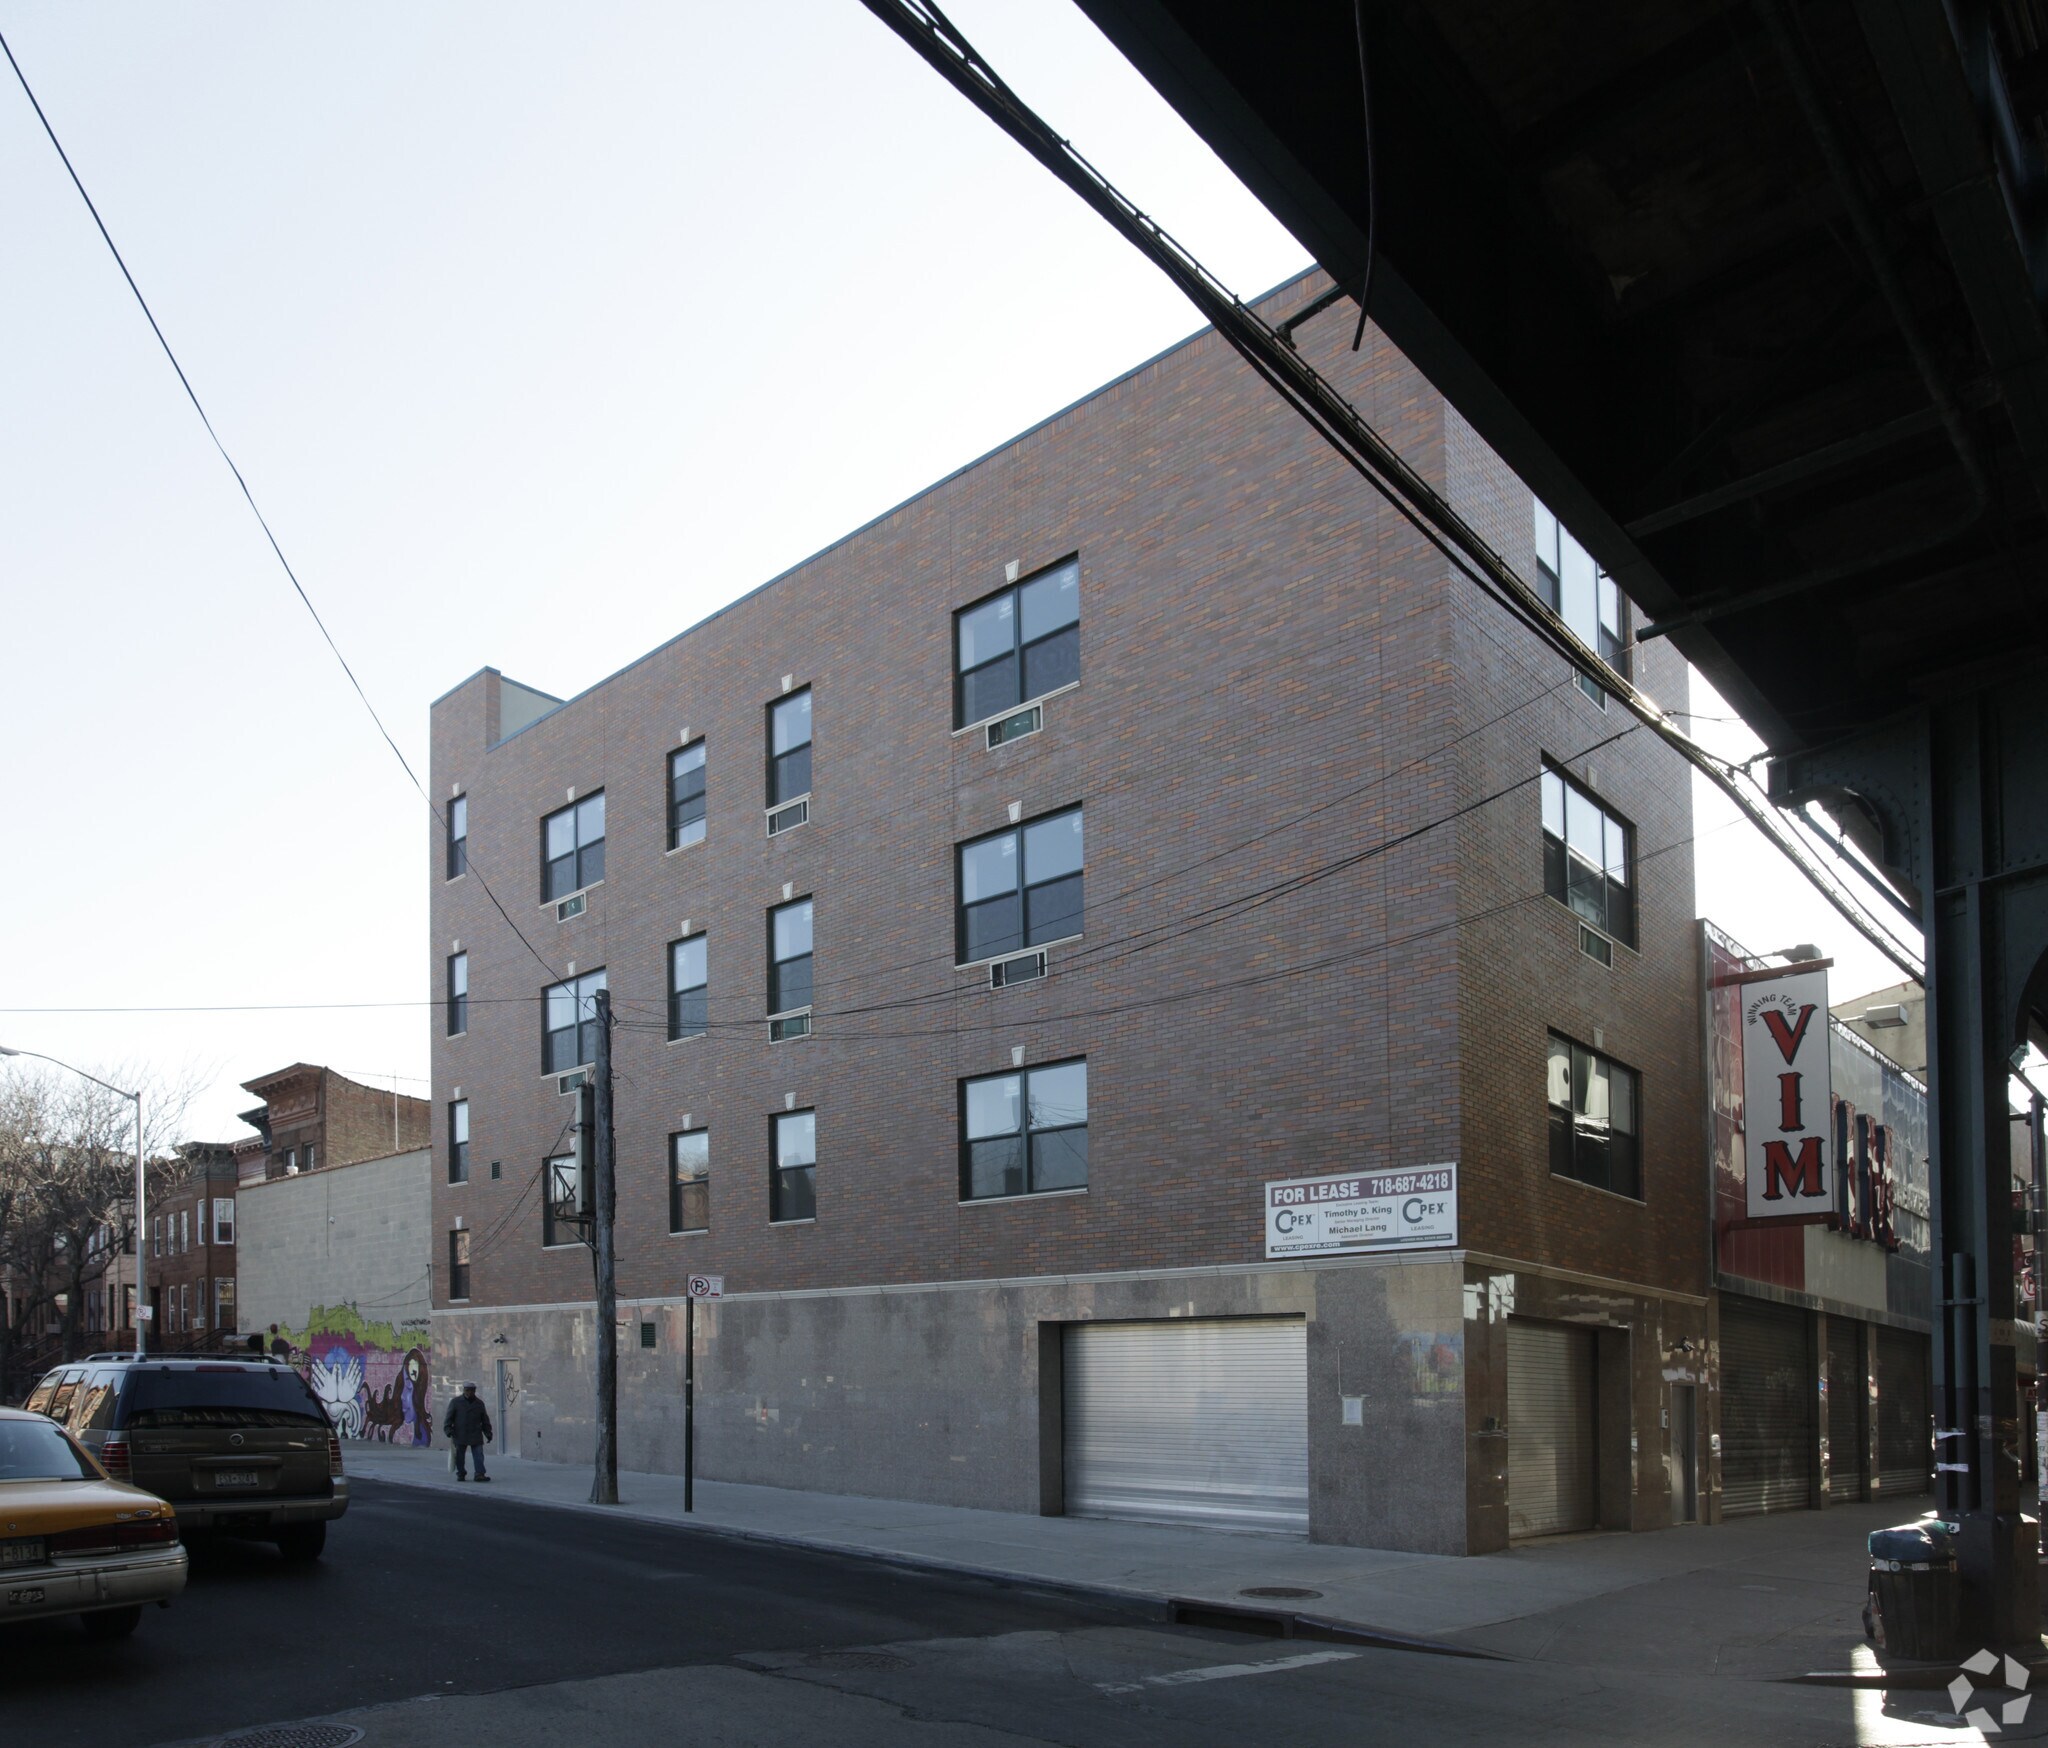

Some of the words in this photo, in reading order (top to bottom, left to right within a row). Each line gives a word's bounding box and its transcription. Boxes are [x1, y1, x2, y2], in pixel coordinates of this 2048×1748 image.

[1747, 994, 1776, 1026] WINNING
[1780, 995, 1797, 1016] TEAM
[1759, 1004, 1828, 1201] VIM
[1274, 1187, 1305, 1205] FOR
[1309, 1181, 1360, 1201] LEASE
[1371, 1172, 1449, 1195] 718-687-4218
[1324, 1208, 1358, 1218] Timothy
[1360, 1207, 1369, 1215] D.
[1372, 1206, 1392, 1215] King
[1329, 1224, 1362, 1235] Michael
[1365, 1224, 1387, 1232] Lang
[1274, 1241, 1341, 1251] www.cpexre.com
